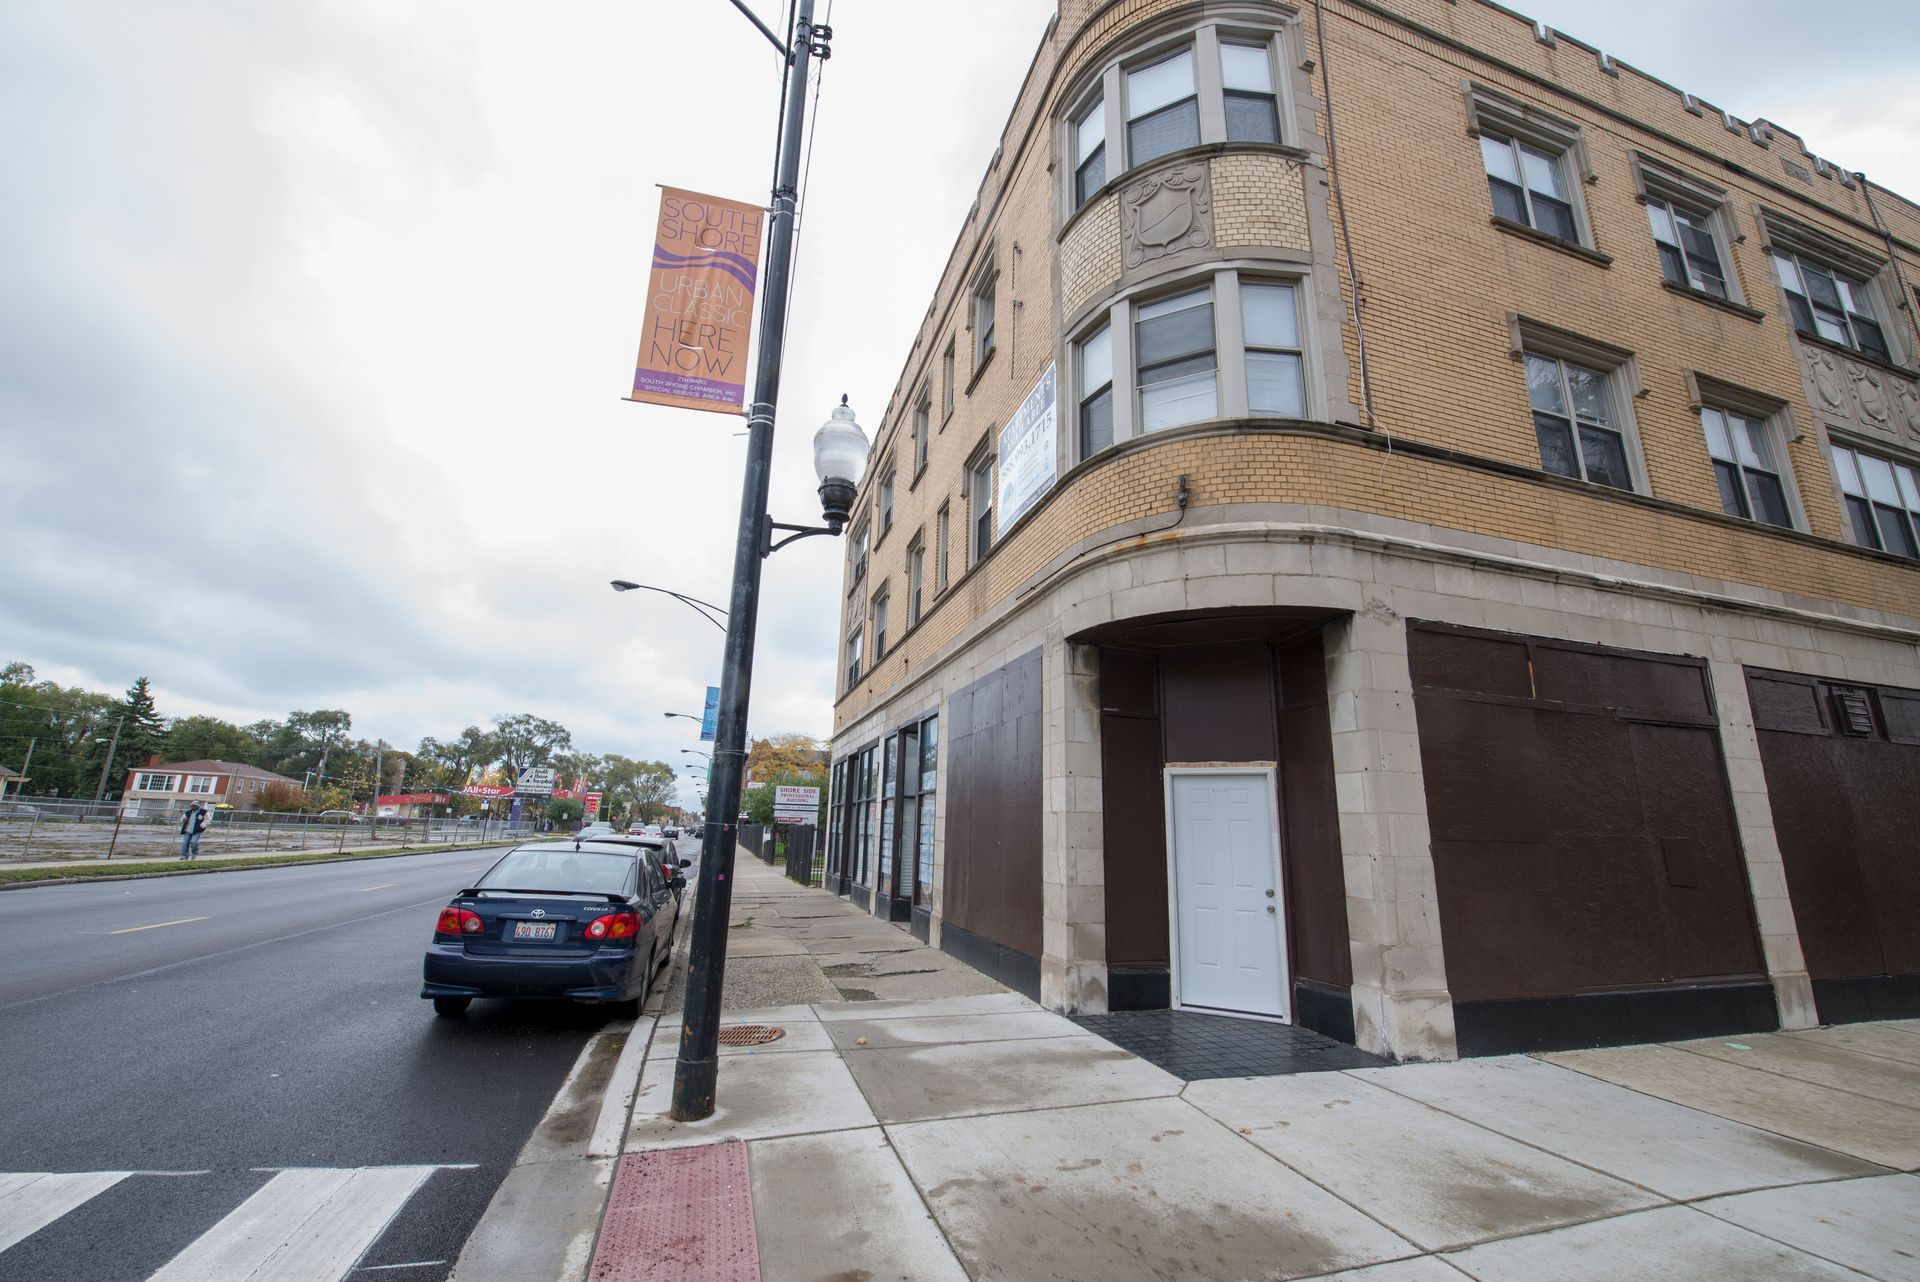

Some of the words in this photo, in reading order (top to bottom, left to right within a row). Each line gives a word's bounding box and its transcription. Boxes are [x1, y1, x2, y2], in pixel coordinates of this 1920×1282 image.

[664, 197, 759, 236] SOUTH
[662, 218, 757, 257] SHORE
[660, 271, 743, 307] URBAN
[653, 293, 747, 328] CLASSIC
[654, 315, 737, 354] HERE
[650, 340, 734, 376] NOW
[640, 377, 664, 385] SOUTH
[665, 381, 688, 390] SHORE
[644, 384, 671, 394] SPECIAL
[672, 389, 700, 398] SERVICE
[702, 393, 720, 401] AREA
[1003, 375, 1052, 447] APARTMENTS
[1007, 396, 1046, 454] AVAILABLE
[534, 926, 555, 939] 8767
